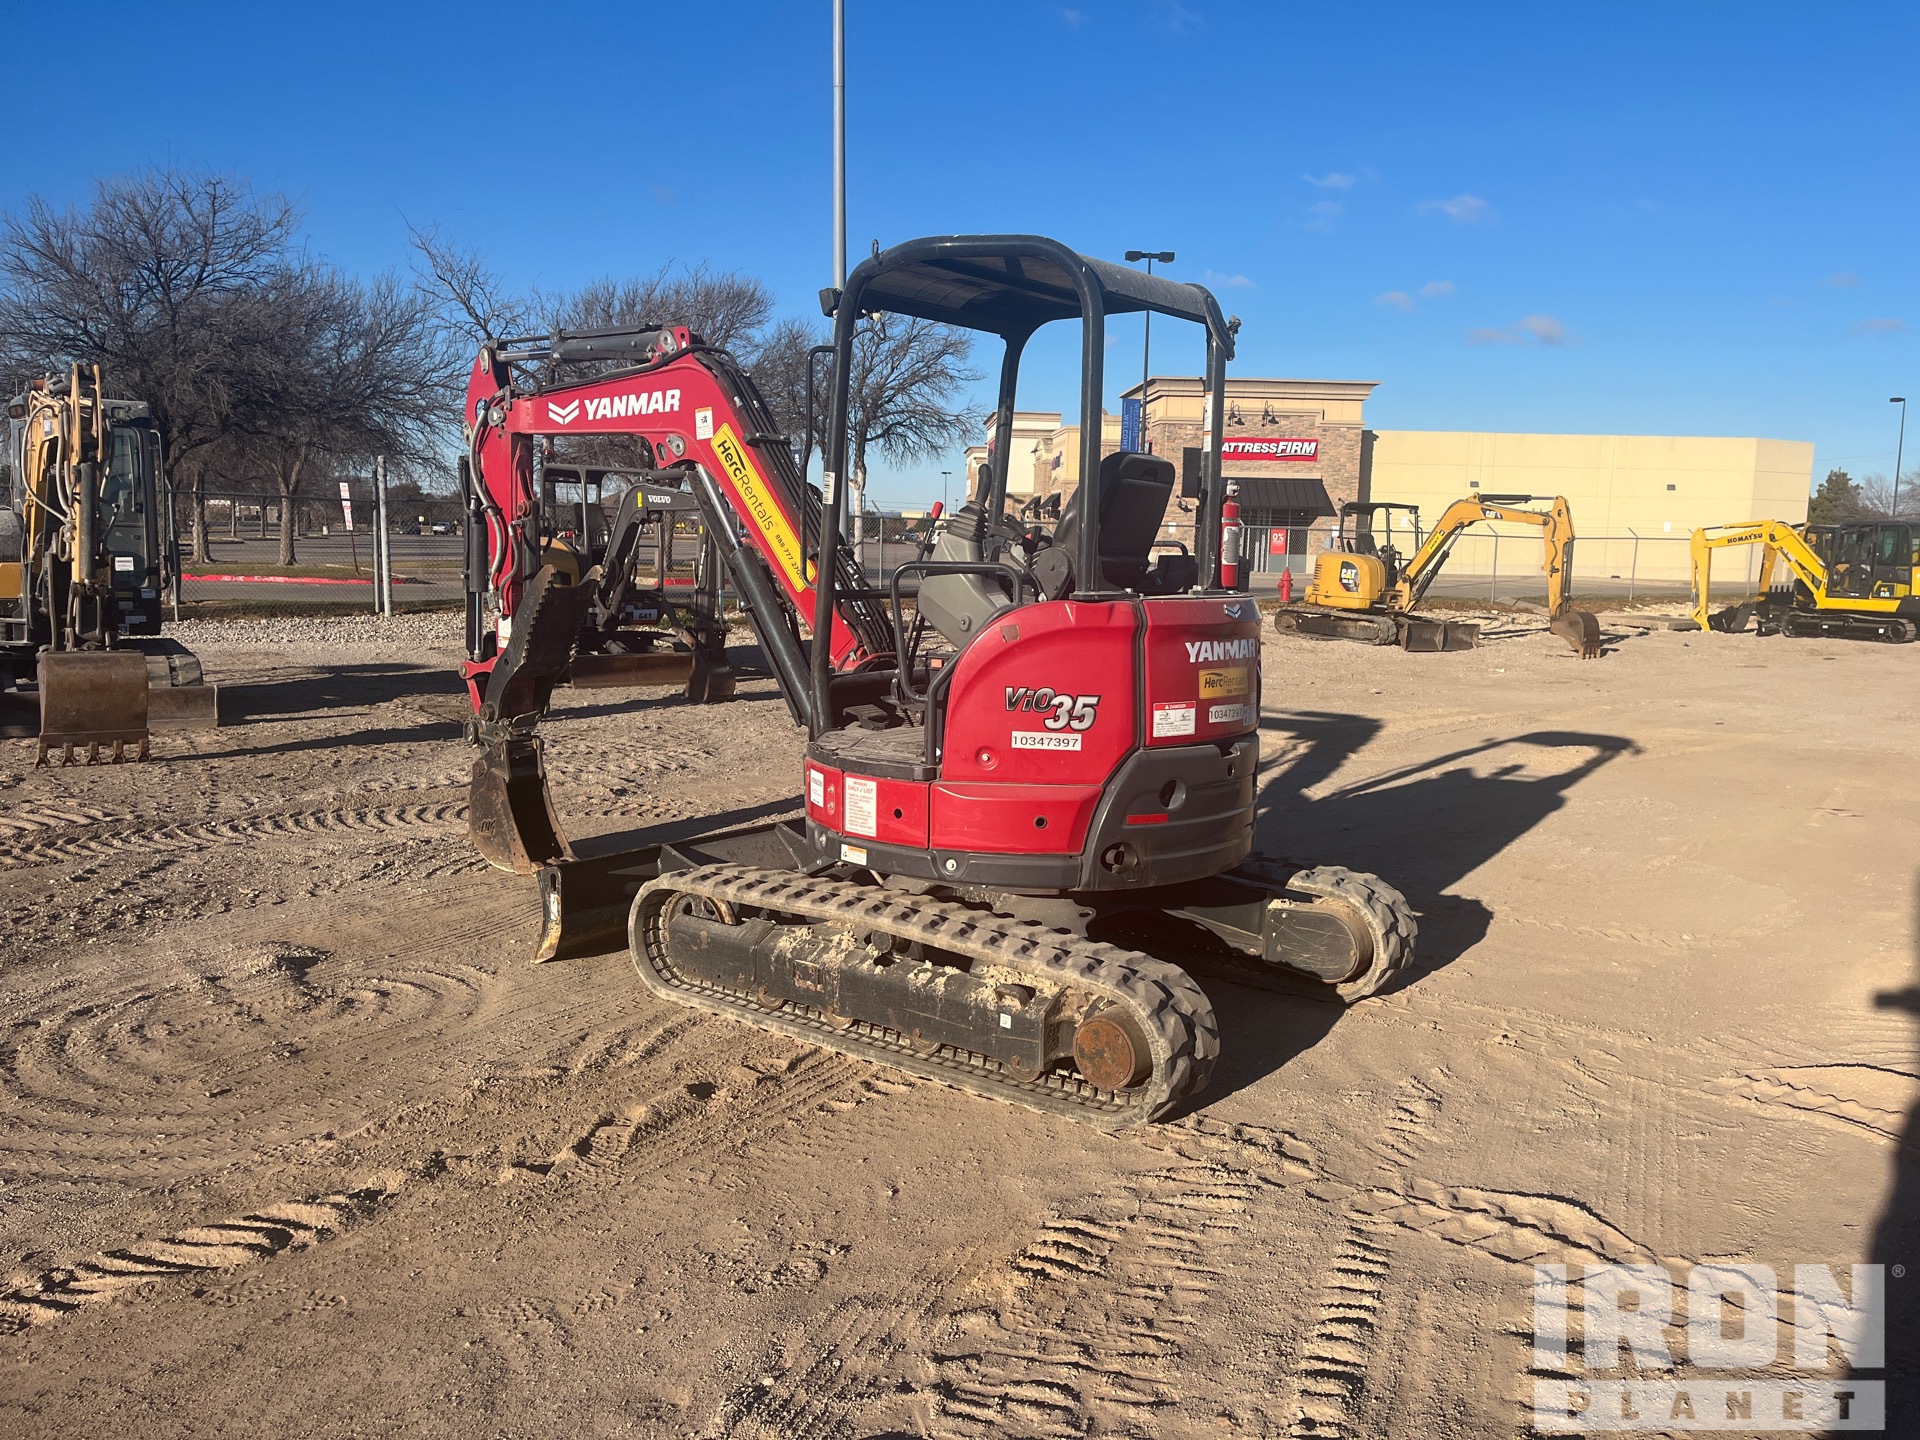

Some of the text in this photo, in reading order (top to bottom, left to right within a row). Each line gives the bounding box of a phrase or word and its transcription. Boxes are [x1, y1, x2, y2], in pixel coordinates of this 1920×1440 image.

[584, 389, 680, 420] YANMAR
[647, 494, 671, 504] VOLVO
[1727, 532, 1763, 544] KOMATSU
[1341, 568, 1357, 579] CAT
[1184, 638, 1256, 663] YANMAR
[1209, 707, 1243, 720] 10347397
[1013, 736, 1079, 748] 10347397
